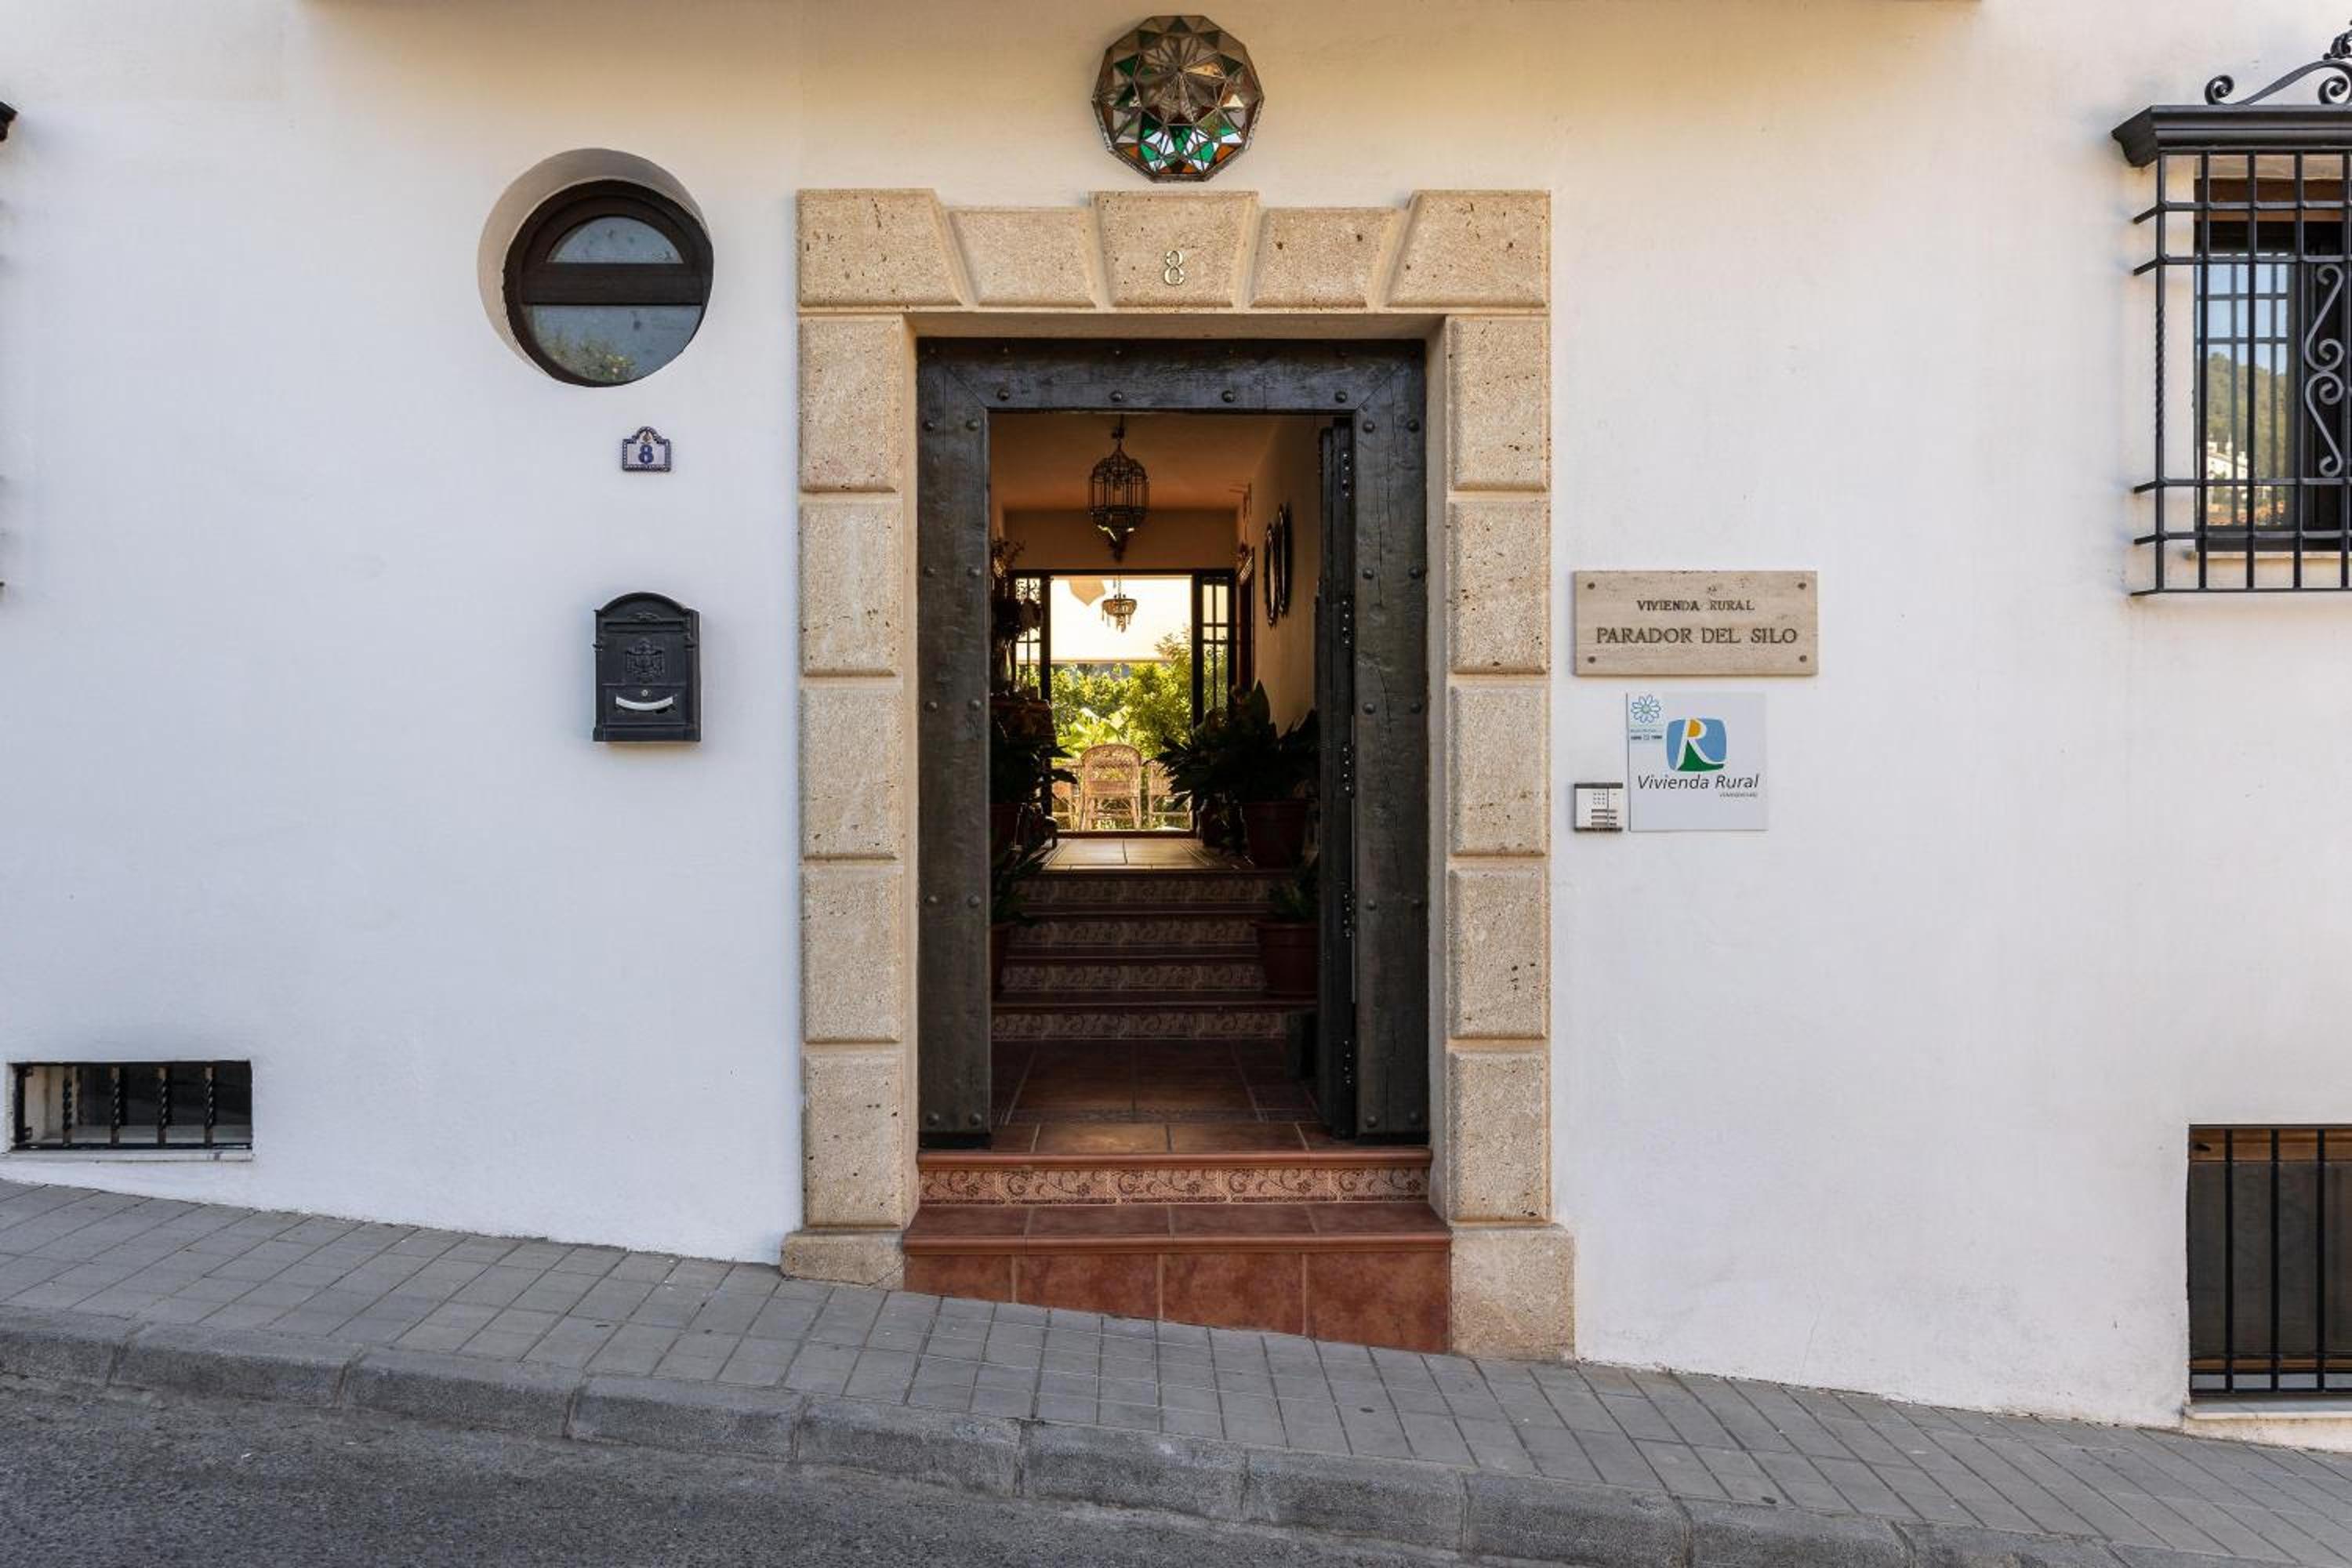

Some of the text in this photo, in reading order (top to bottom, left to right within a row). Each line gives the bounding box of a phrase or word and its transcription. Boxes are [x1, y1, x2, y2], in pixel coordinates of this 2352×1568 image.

[1163, 250, 1185, 286] 8
[638, 445, 654, 464] 8
[1637, 600, 1755, 612] VIVIENDA RURAL
[1596, 627, 1798, 644] PARADOR DEL SILO
[1637, 773, 1759, 789] Vivienda Rural
